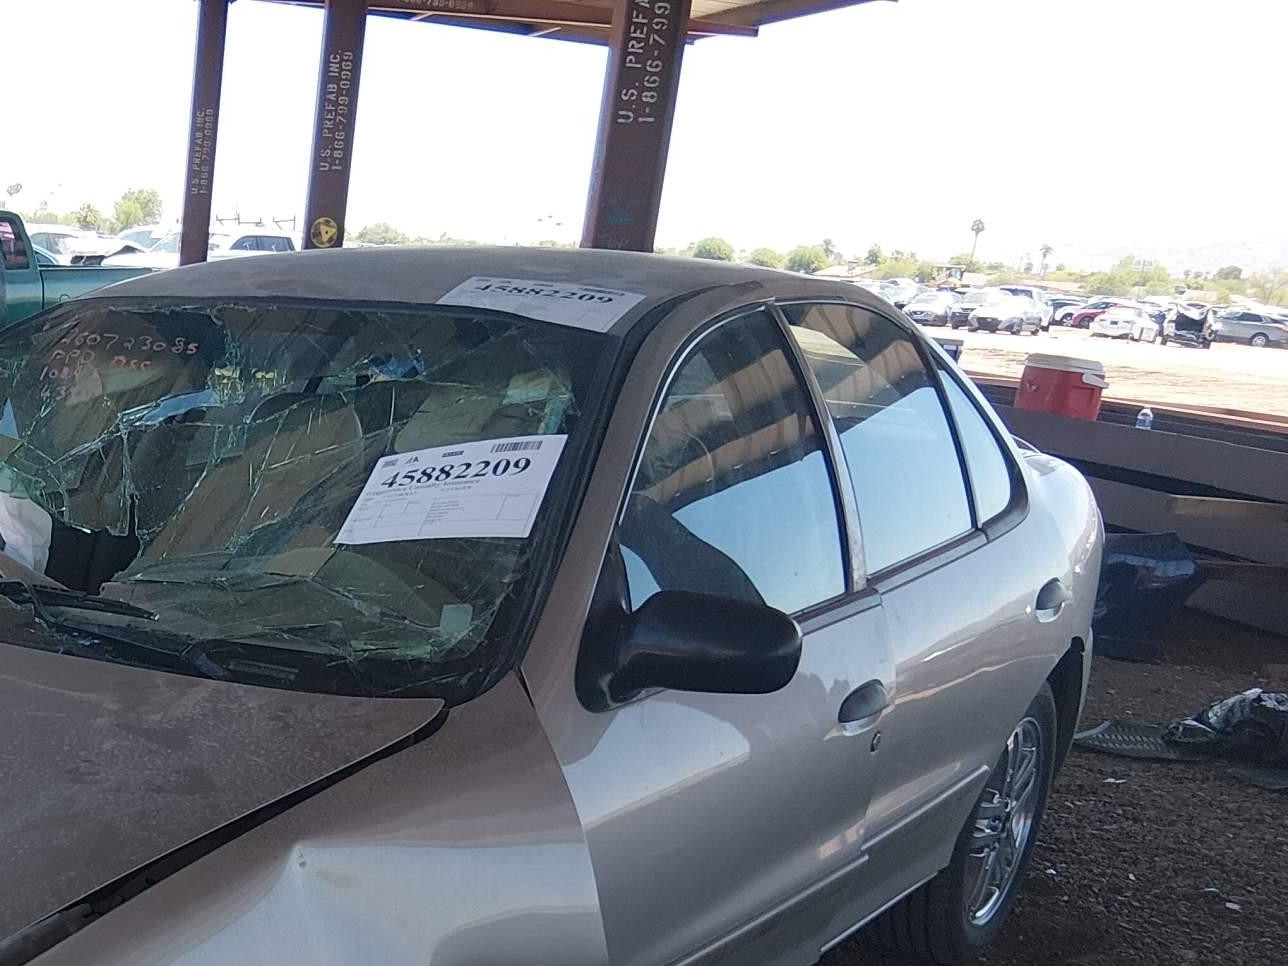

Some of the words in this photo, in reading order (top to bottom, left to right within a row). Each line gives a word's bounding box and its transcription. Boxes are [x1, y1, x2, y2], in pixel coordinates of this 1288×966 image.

[328, 50, 341, 76] INC.
[323, 83, 337, 137] PREFAB
[332, 51, 353, 170] 1-866-799-0969
[617, 82, 639, 123] U.S.
[319, 145, 332, 171] U.S.
[474, 284, 614, 304] 45882209
[381, 457, 532, 489] 45882209
